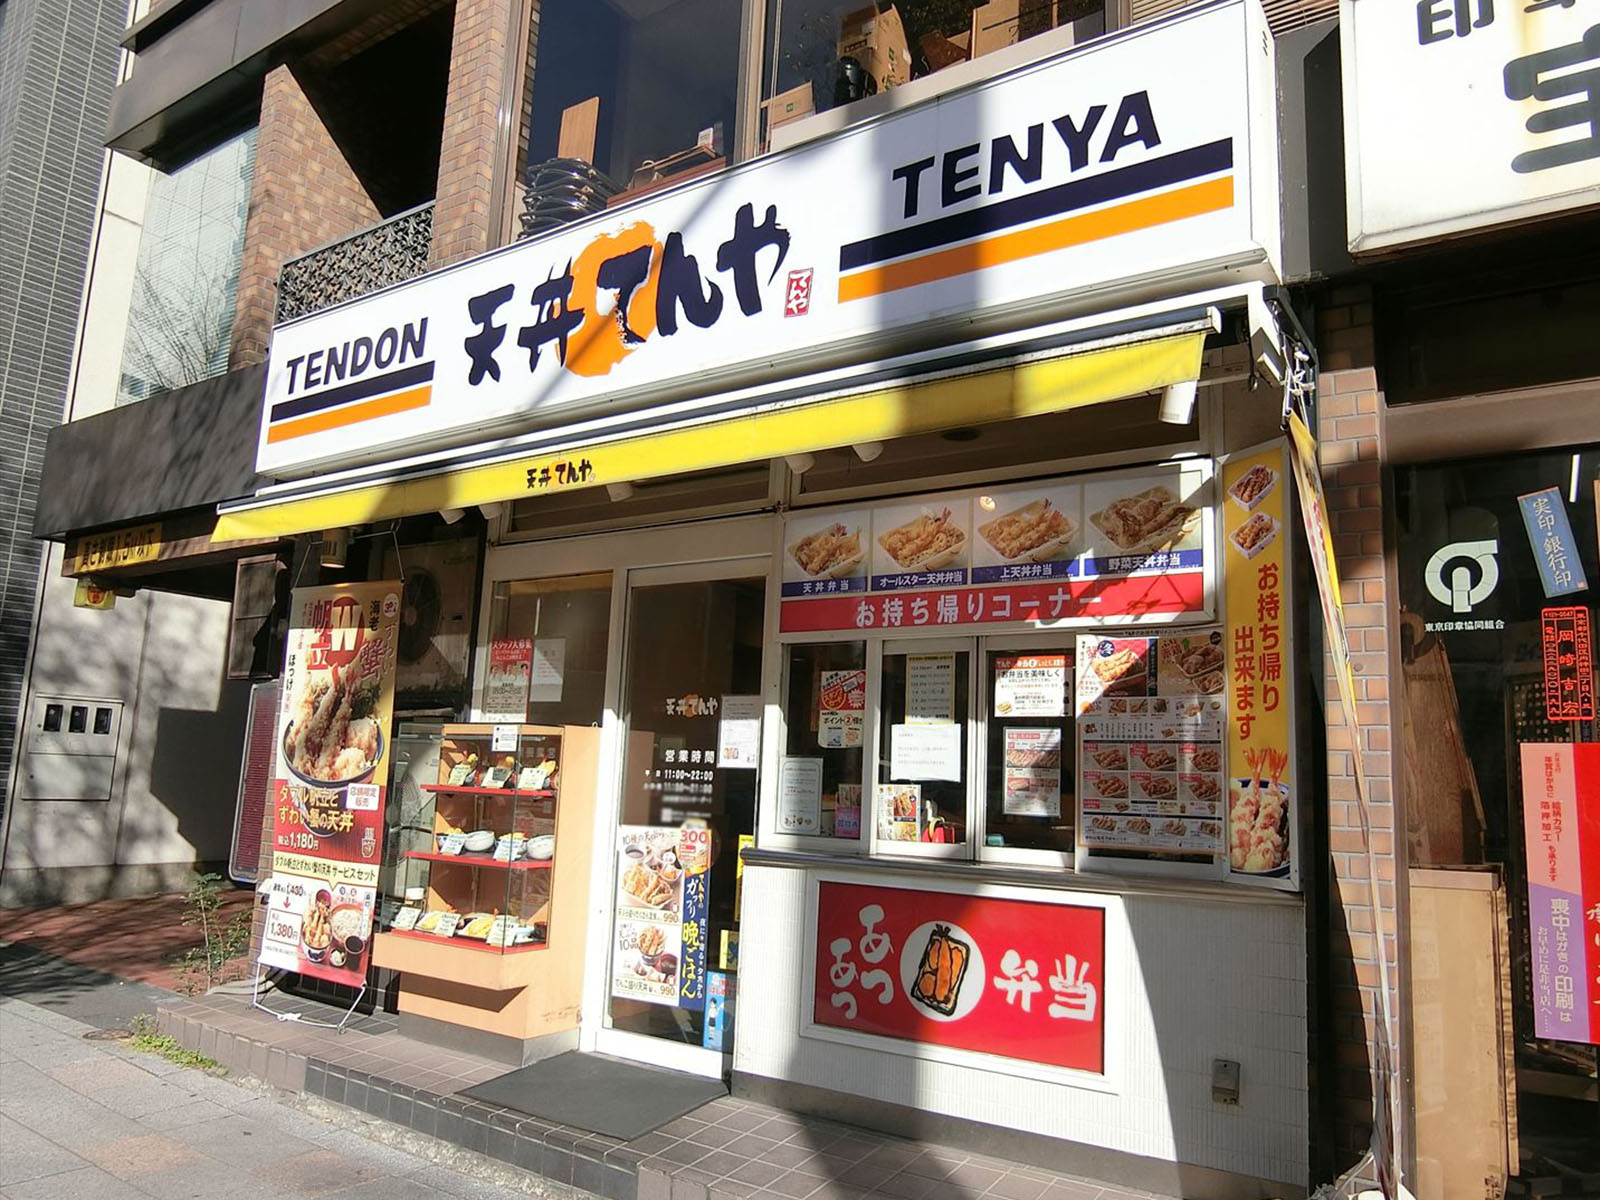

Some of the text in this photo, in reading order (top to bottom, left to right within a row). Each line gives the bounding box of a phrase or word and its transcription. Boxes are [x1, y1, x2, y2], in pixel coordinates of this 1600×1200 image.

[892, 90, 1162, 218] TENYA
[286, 317, 429, 394] TENDON
[1108, 553, 1181, 570] 野菜天丼弁当
[1533, 498, 1571, 587] 実印・銀行印
[802, 580, 849, 593] 天丼弁当
[879, 571, 963, 587] オールスター天丼弁当
[1000, 564, 1052, 578] 上天丼弁当
[856, 586, 1102, 628] お持ち帰りコーナー
[1425, 619, 1505, 632] 東京印章協同組合
[1257, 562, 1281, 712] お持ち帰り
[1234, 625, 1256, 740] 出来ます
[665, 750, 715, 763] 営業時間
[993, 949, 1097, 1022] 弁当
